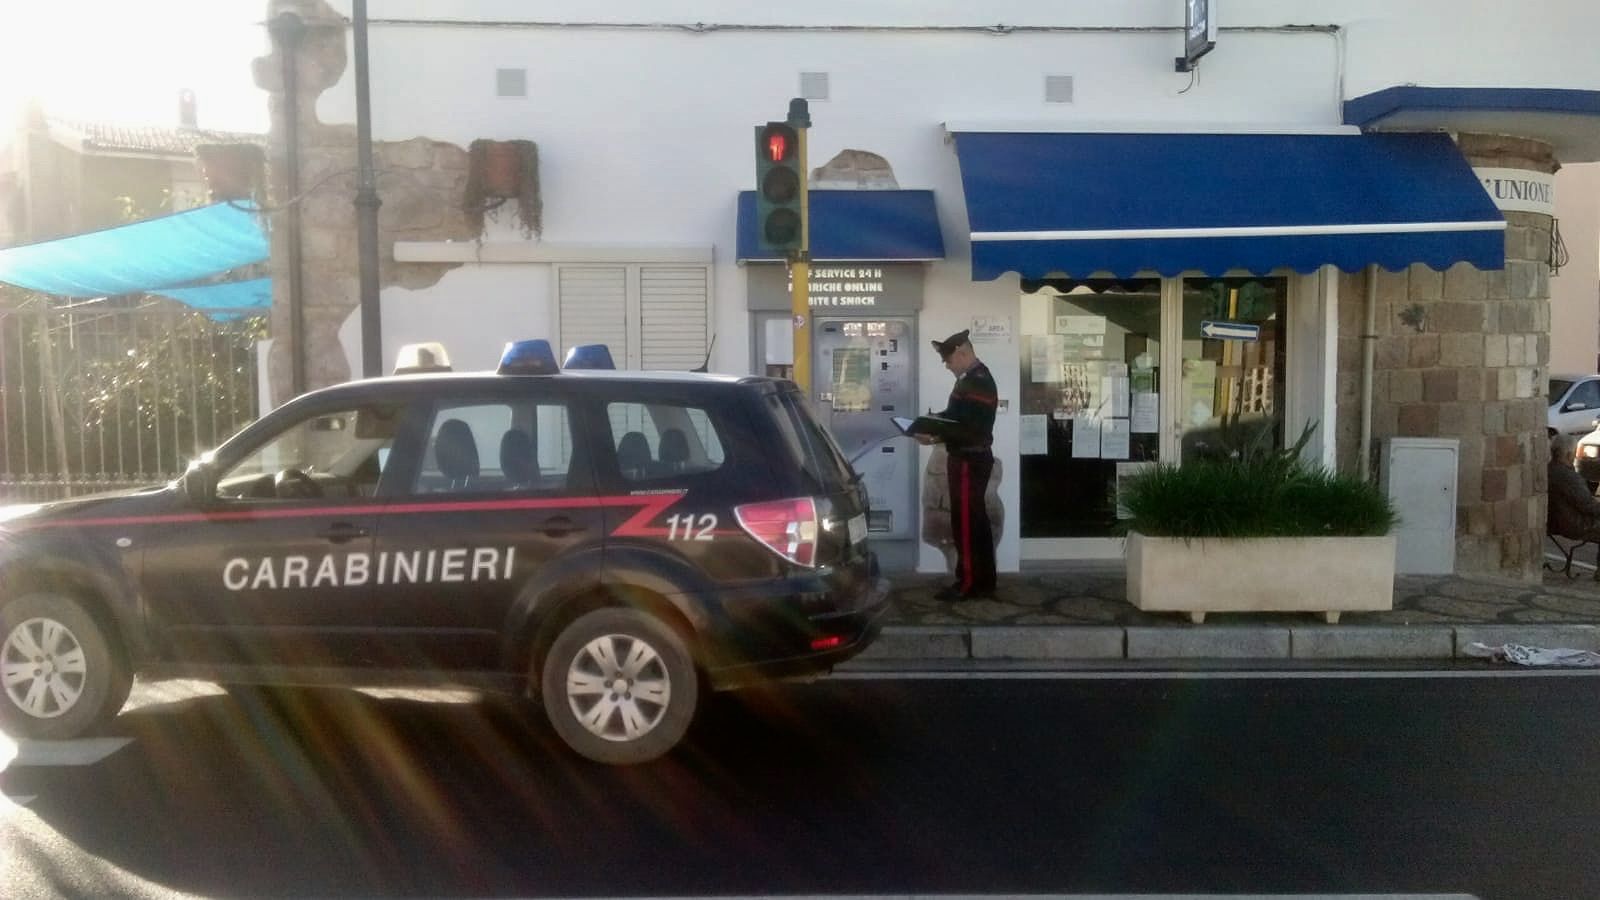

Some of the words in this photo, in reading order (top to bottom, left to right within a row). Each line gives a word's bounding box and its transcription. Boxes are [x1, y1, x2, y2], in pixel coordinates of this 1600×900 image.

[1483, 179, 1550, 203] 'UNIONE
[788, 269, 813, 278] SF
[815, 269, 856, 278] SERVICE
[858, 269, 872, 278] 24
[874, 269, 882, 278] H
[844, 283, 883, 292] ONLINE
[831, 296, 838, 305] E
[840, 296, 875, 305] SNACK
[665, 513, 718, 541] 112
[222, 546, 516, 591] CARABINIERI
